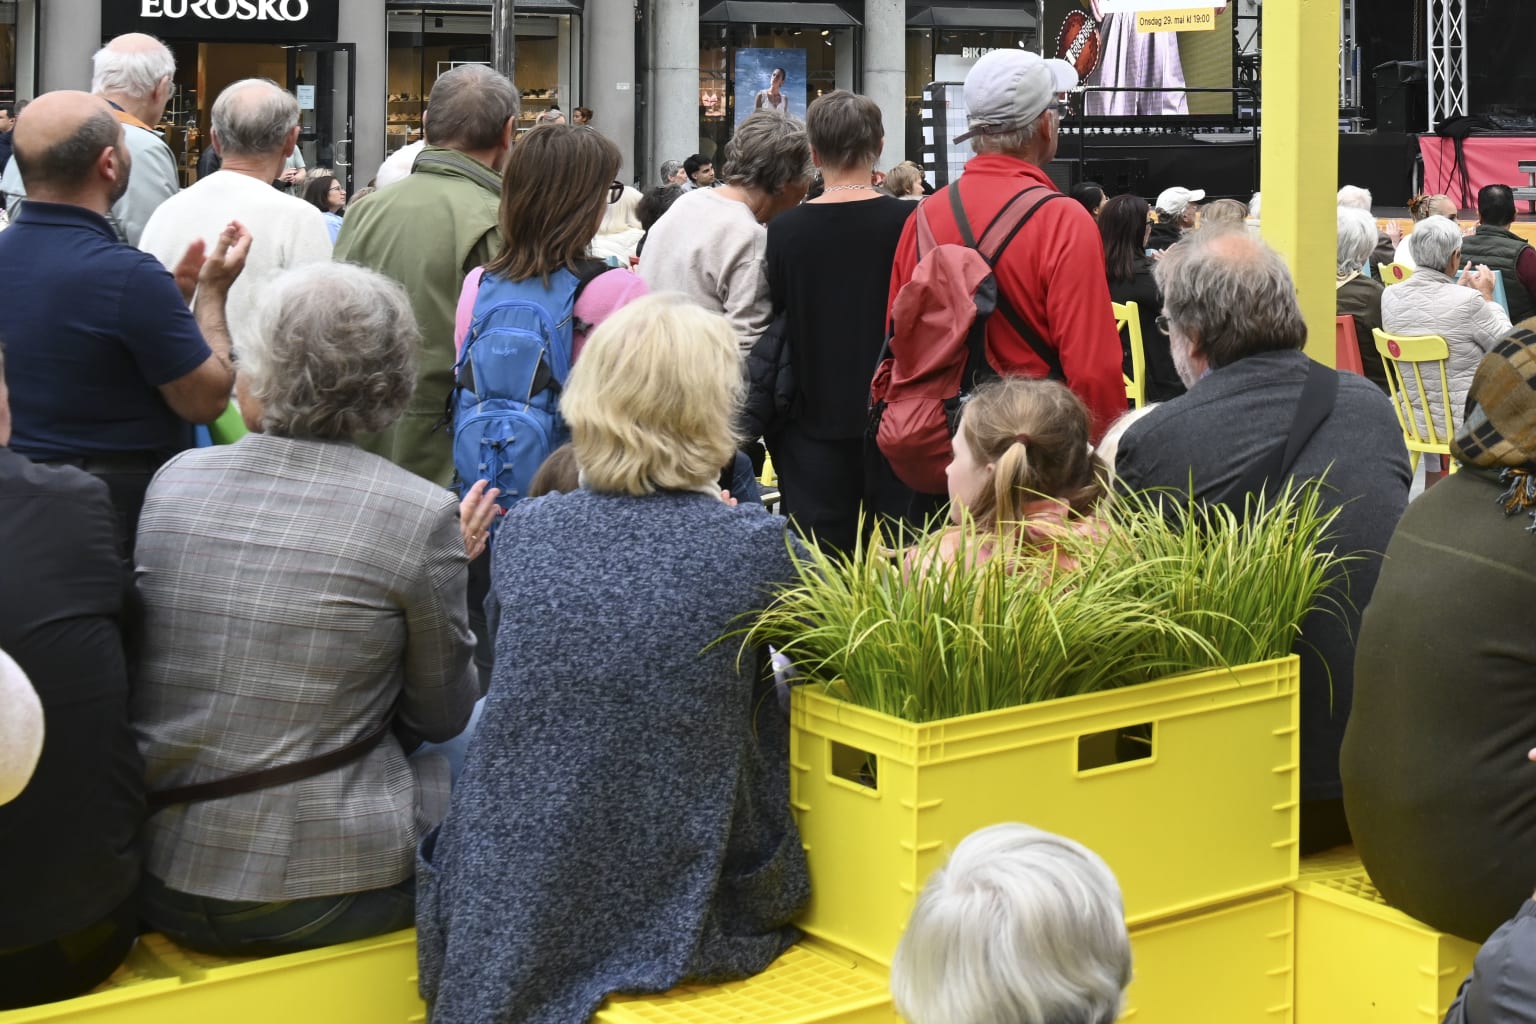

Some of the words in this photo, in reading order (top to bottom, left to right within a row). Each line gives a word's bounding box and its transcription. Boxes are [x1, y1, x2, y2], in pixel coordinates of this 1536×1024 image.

[1139, 16, 1162, 27] Onsdag
[1163, 16, 1173, 25] 29.
[1174, 15, 1185, 24] mai
[1186, 14, 1192, 23] kl
[1193, 13, 1210, 23] 19:00
